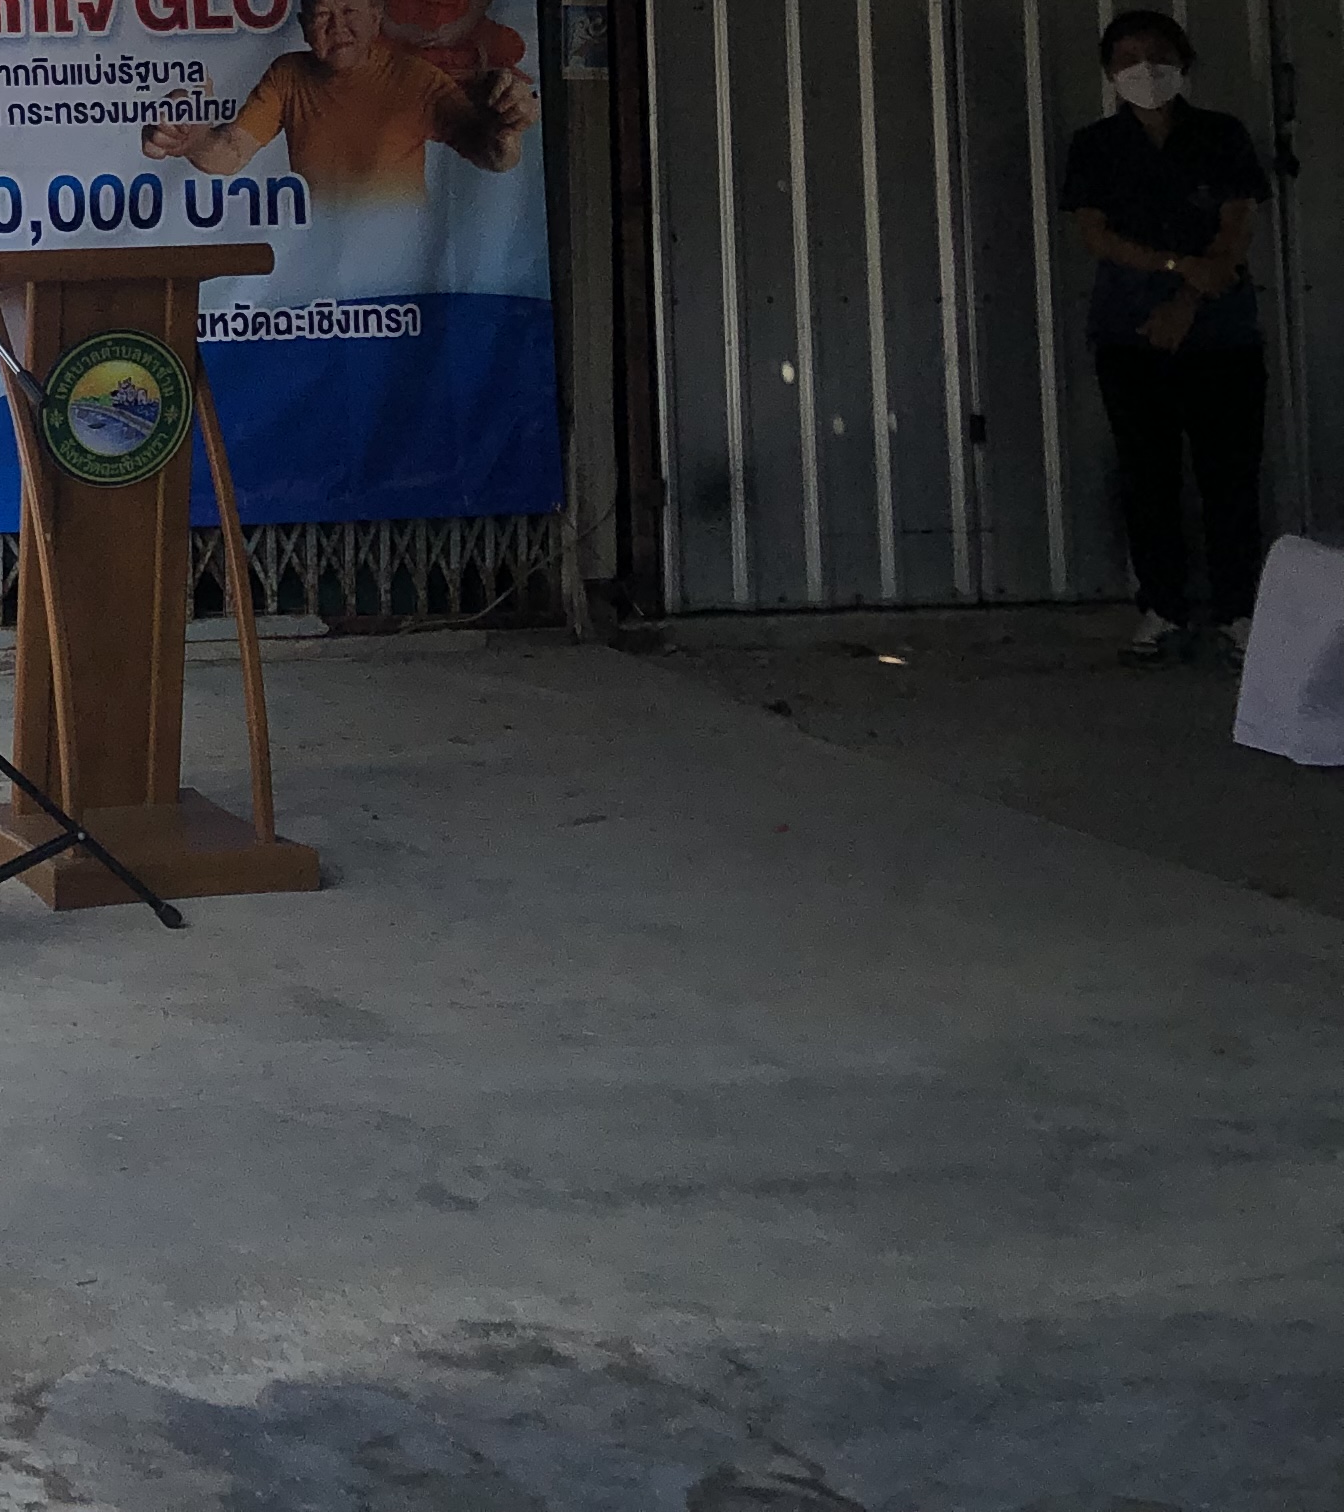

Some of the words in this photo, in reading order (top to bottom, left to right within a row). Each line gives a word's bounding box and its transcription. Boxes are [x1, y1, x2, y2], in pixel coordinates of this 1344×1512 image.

[7, 90, 237, 127] กระทรวงมหาดไทย
[184, 174, 307, 229] บาท
